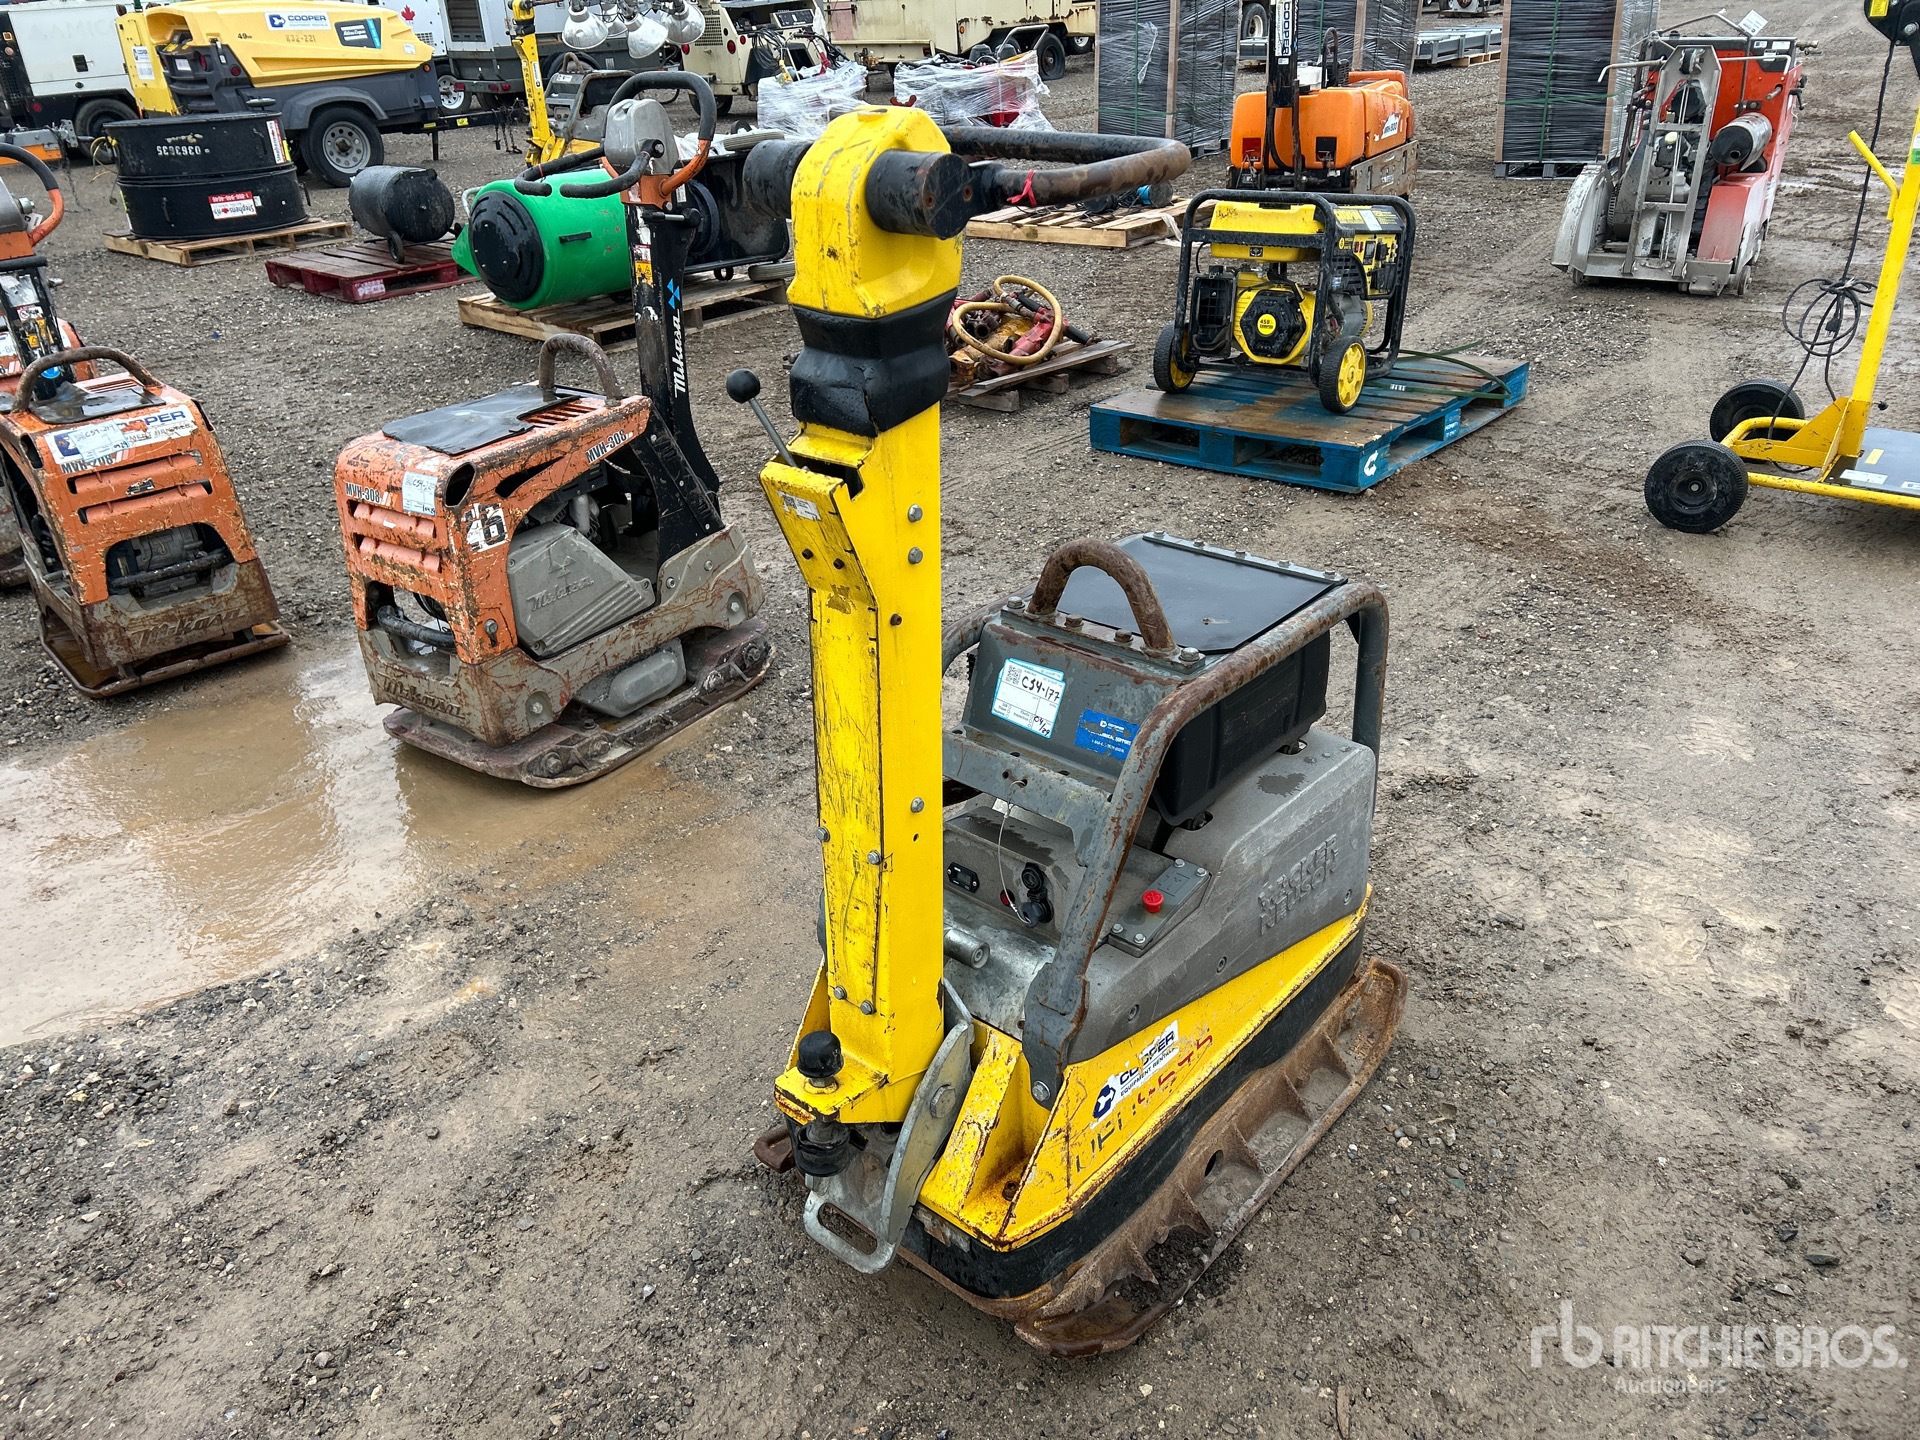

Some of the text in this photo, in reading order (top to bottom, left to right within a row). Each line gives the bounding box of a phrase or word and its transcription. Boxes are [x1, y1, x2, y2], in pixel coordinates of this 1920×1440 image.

[1282, 1, 1291, 55] COOPER
[268, 122, 281, 162] Stephensn's
[213, 203, 255, 217] Stephensn's
[672, 309, 687, 399] Mikasa
[116, 410, 186, 428] PER
[585, 429, 627, 463] MVH-308
[345, 482, 381, 503] MVH-308
[1033, 715, 1051, 737] 04/29
[1120, 1067, 1152, 1097] EQUIPMENT
